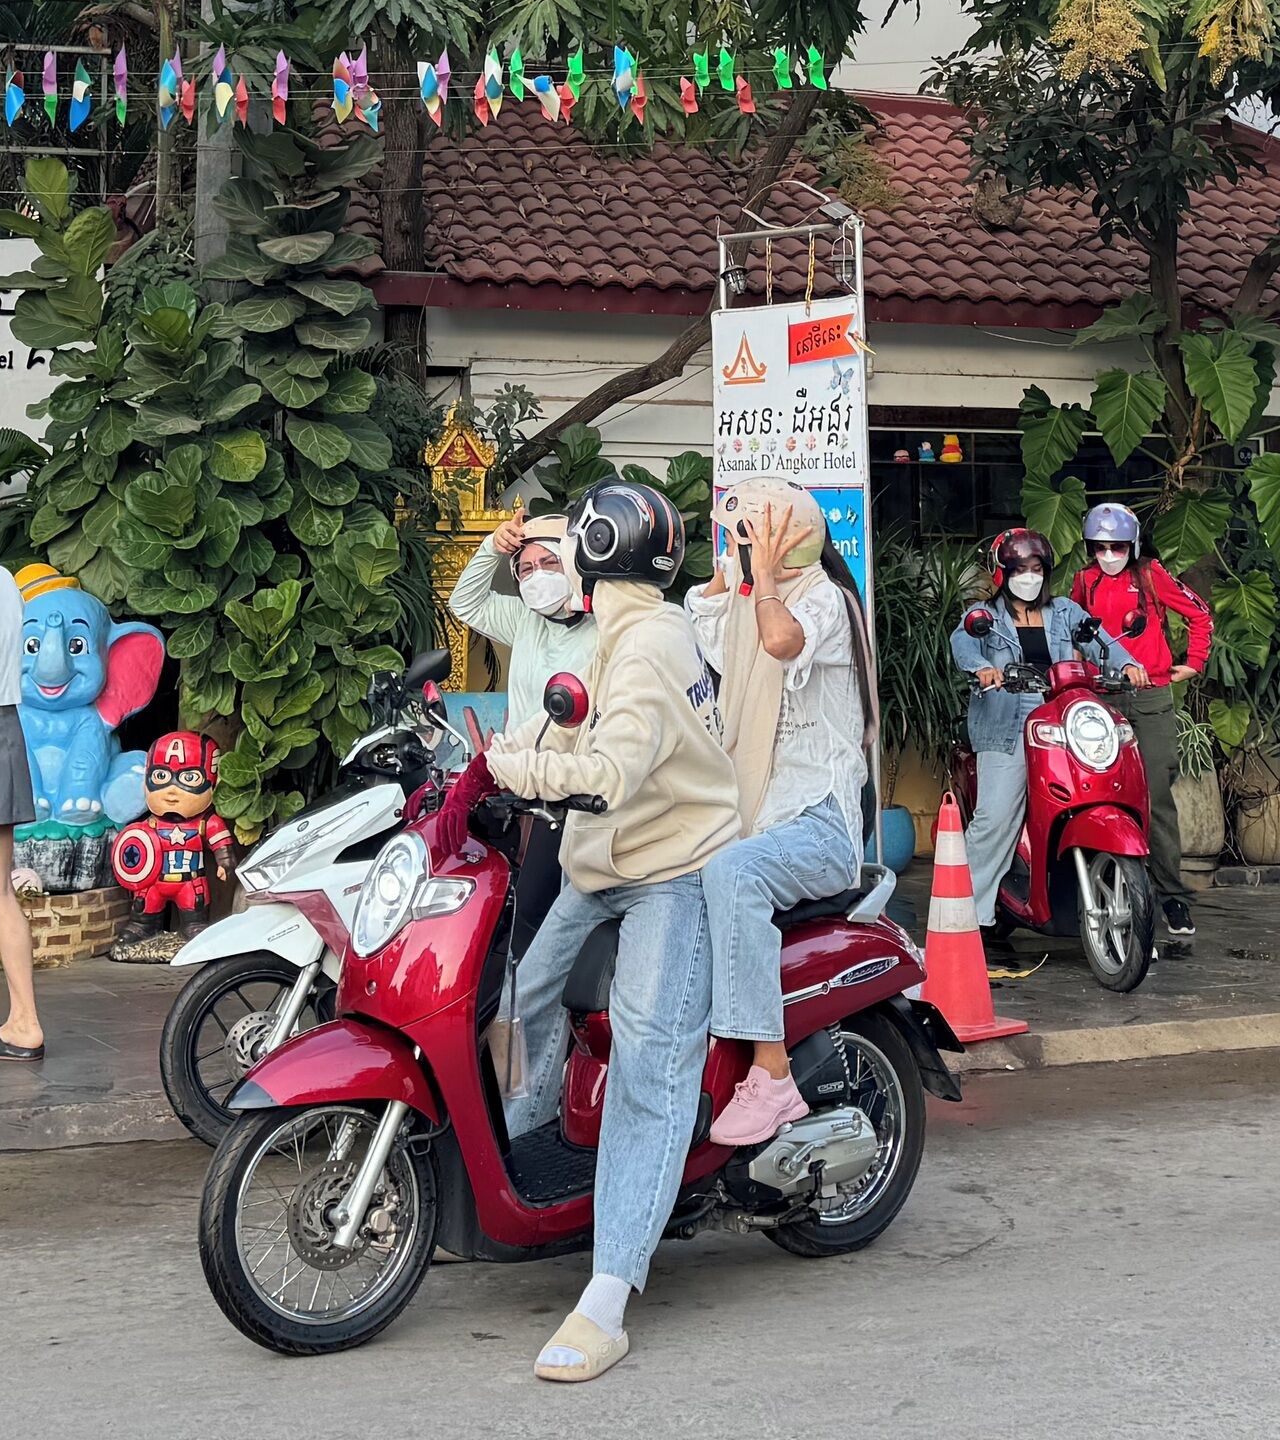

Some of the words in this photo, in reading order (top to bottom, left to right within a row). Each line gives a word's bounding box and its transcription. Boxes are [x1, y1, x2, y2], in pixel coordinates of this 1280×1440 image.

[717, 453, 757, 472] Asanak
[761, 452, 820, 474] D'Angkor
[823, 451, 857, 469] Hotel
[165, 739, 185, 764] A
